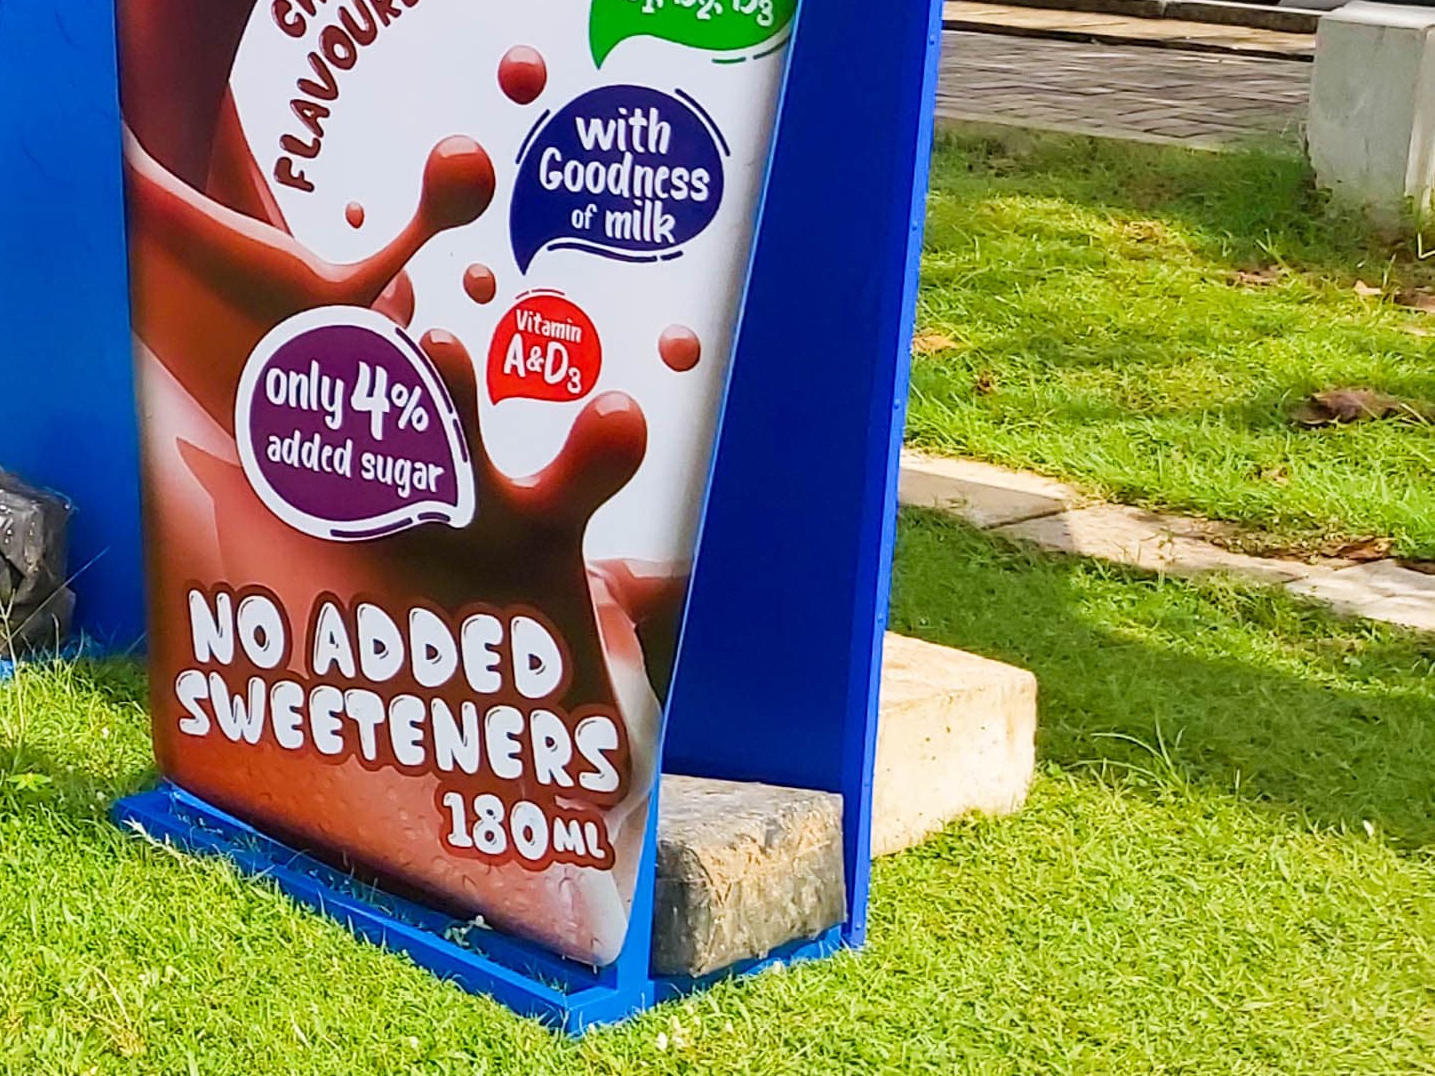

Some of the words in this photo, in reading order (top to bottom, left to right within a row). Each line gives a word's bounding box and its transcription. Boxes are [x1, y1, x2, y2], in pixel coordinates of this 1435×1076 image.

[575, 106, 671, 155] with
[539, 148, 710, 203] Goodness
[571, 202, 594, 231] of
[604, 200, 676, 243] milk
[516, 308, 582, 343] Vitamin
[266, 360, 343, 430] only
[350, 360, 429, 440] 4%
[266, 431, 352, 480] added
[361, 450, 445, 499] sugar
[187, 588, 287, 669] NO
[312, 602, 564, 700] ADDED
[174, 668, 621, 795] SWEETENERS
